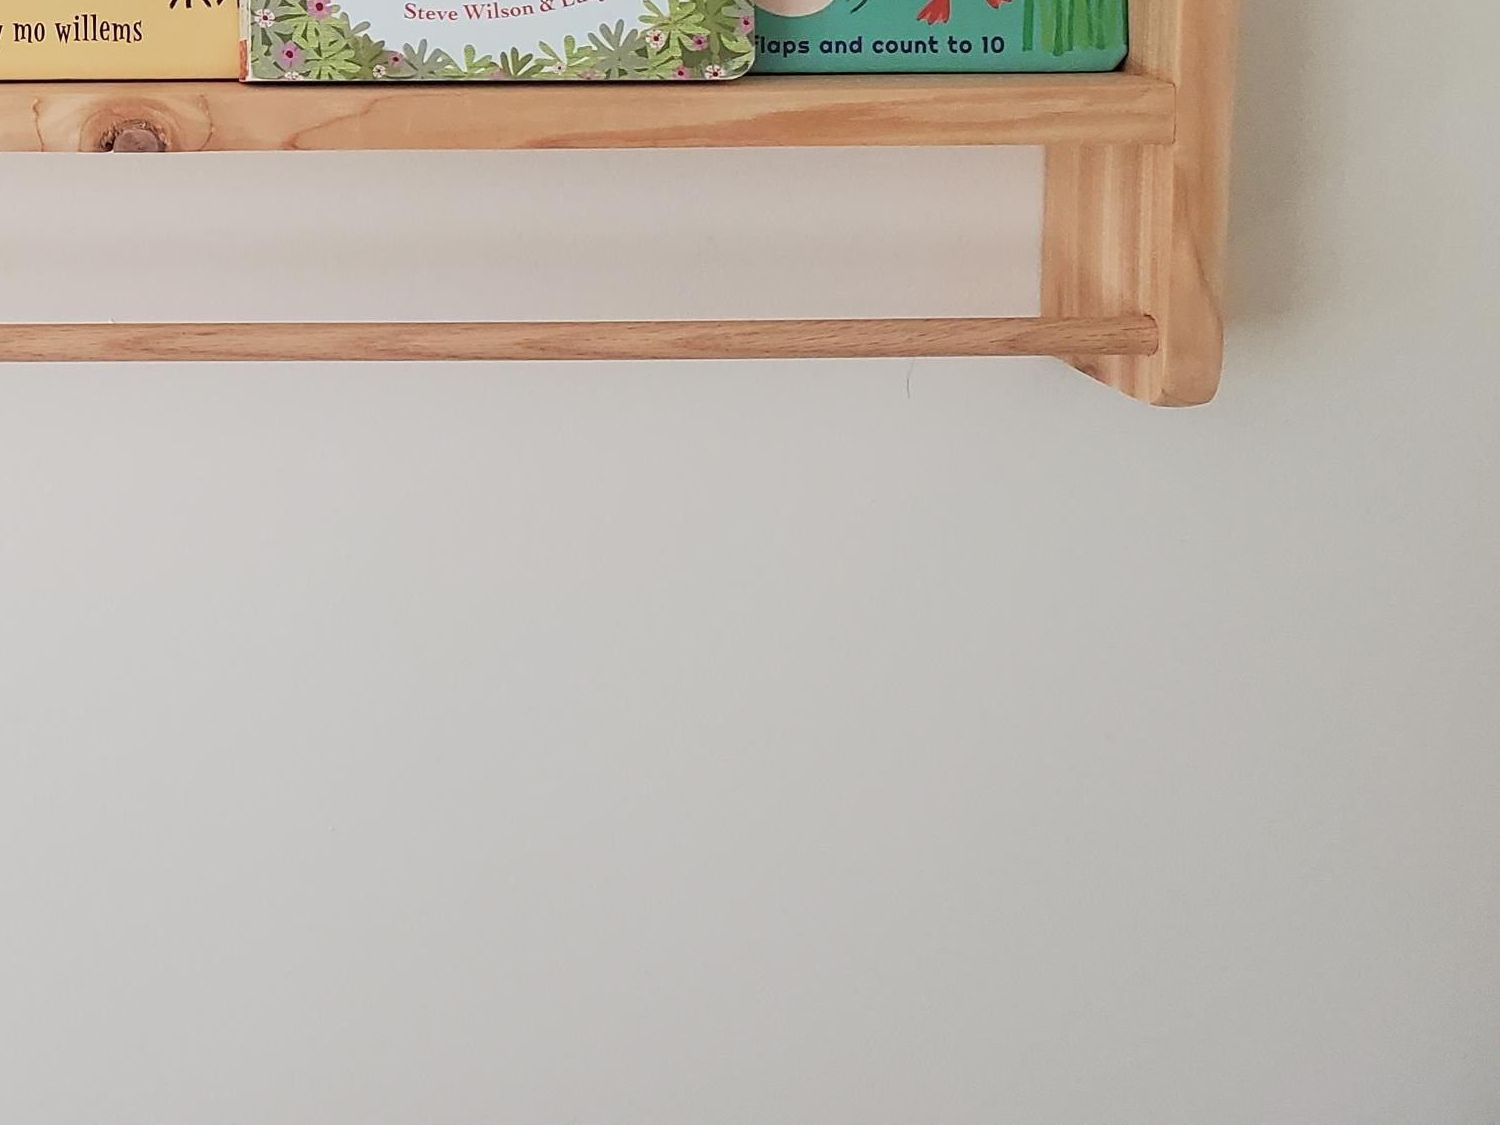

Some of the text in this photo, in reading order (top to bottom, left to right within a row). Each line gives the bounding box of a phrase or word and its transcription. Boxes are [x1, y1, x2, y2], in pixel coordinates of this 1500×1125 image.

[404, 1, 458, 21] Steve
[465, 2, 534, 20] Wilson
[13, 23, 45, 43] mo
[55, 14, 142, 43] willems
[819, 36, 862, 54] and
[872, 36, 938, 54] count
[948, 35, 973, 54] to
[982, 36, 1004, 53] 10
